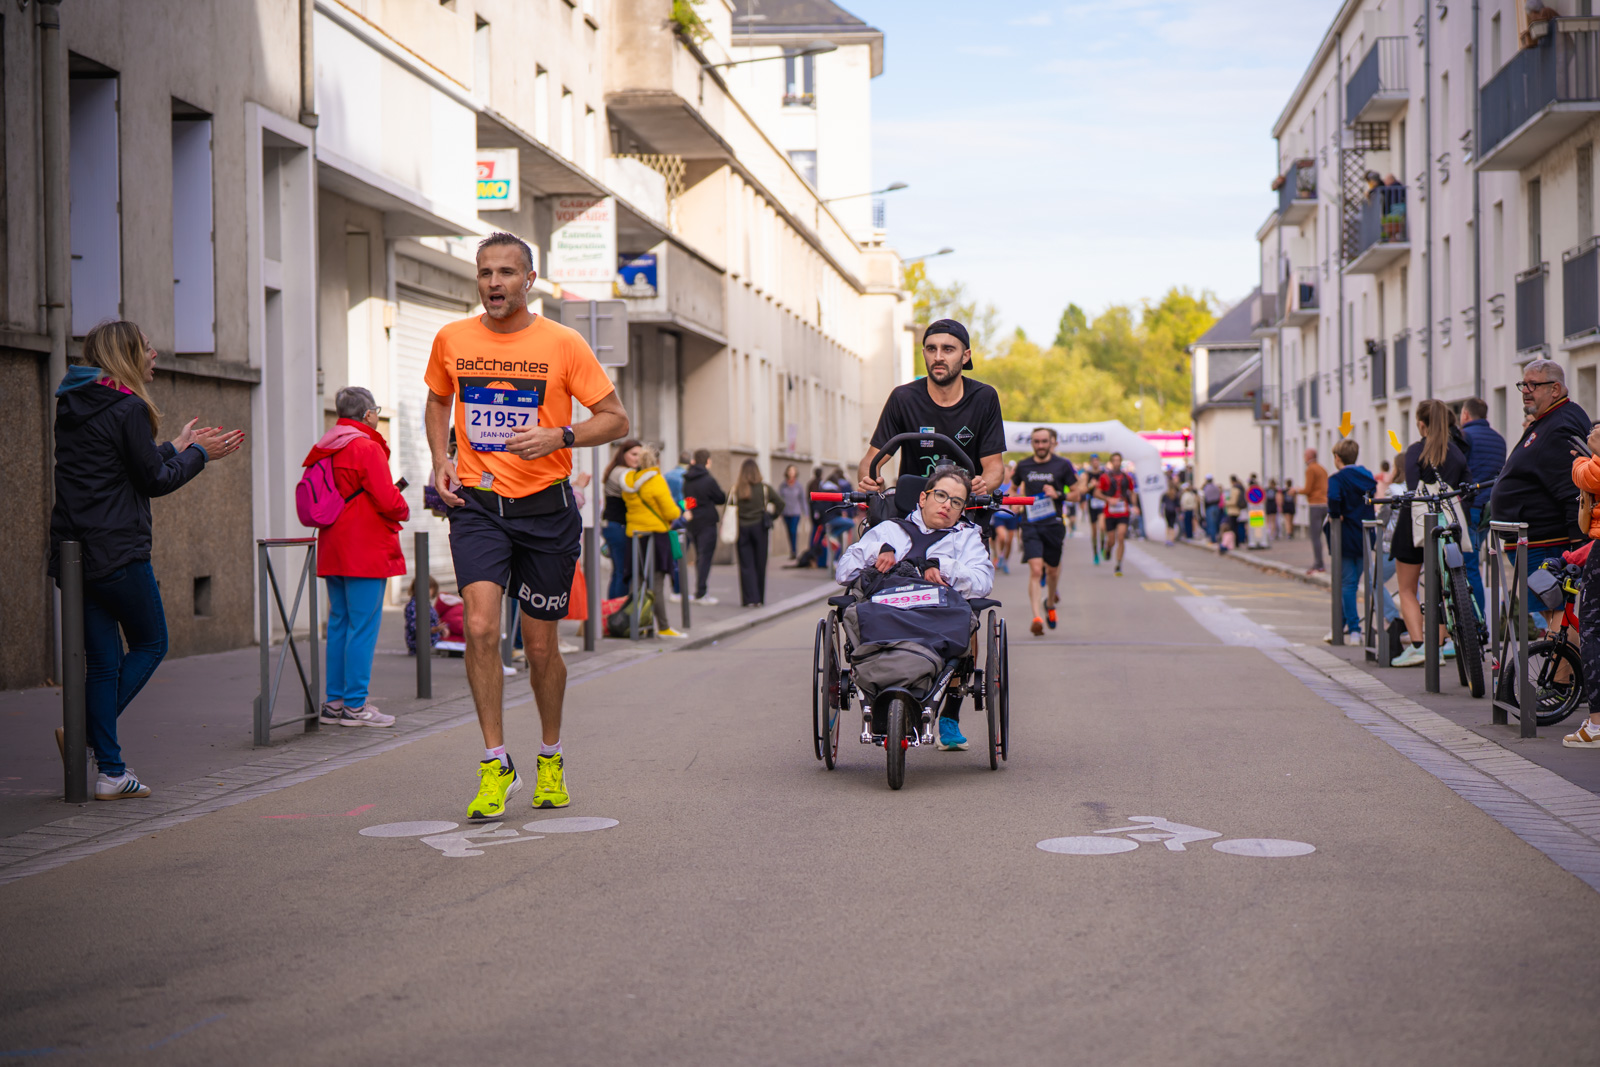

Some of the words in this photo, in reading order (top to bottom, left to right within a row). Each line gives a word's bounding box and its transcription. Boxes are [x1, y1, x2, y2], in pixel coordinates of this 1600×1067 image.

[559, 199, 606, 208] GARAGE
[555, 210, 609, 222] VOLTAIRE
[456, 358, 549, 374] Bacchantes
[471, 409, 530, 428] 21957
[518, 582, 568, 611] BORG
[880, 593, 932, 604] 42936
